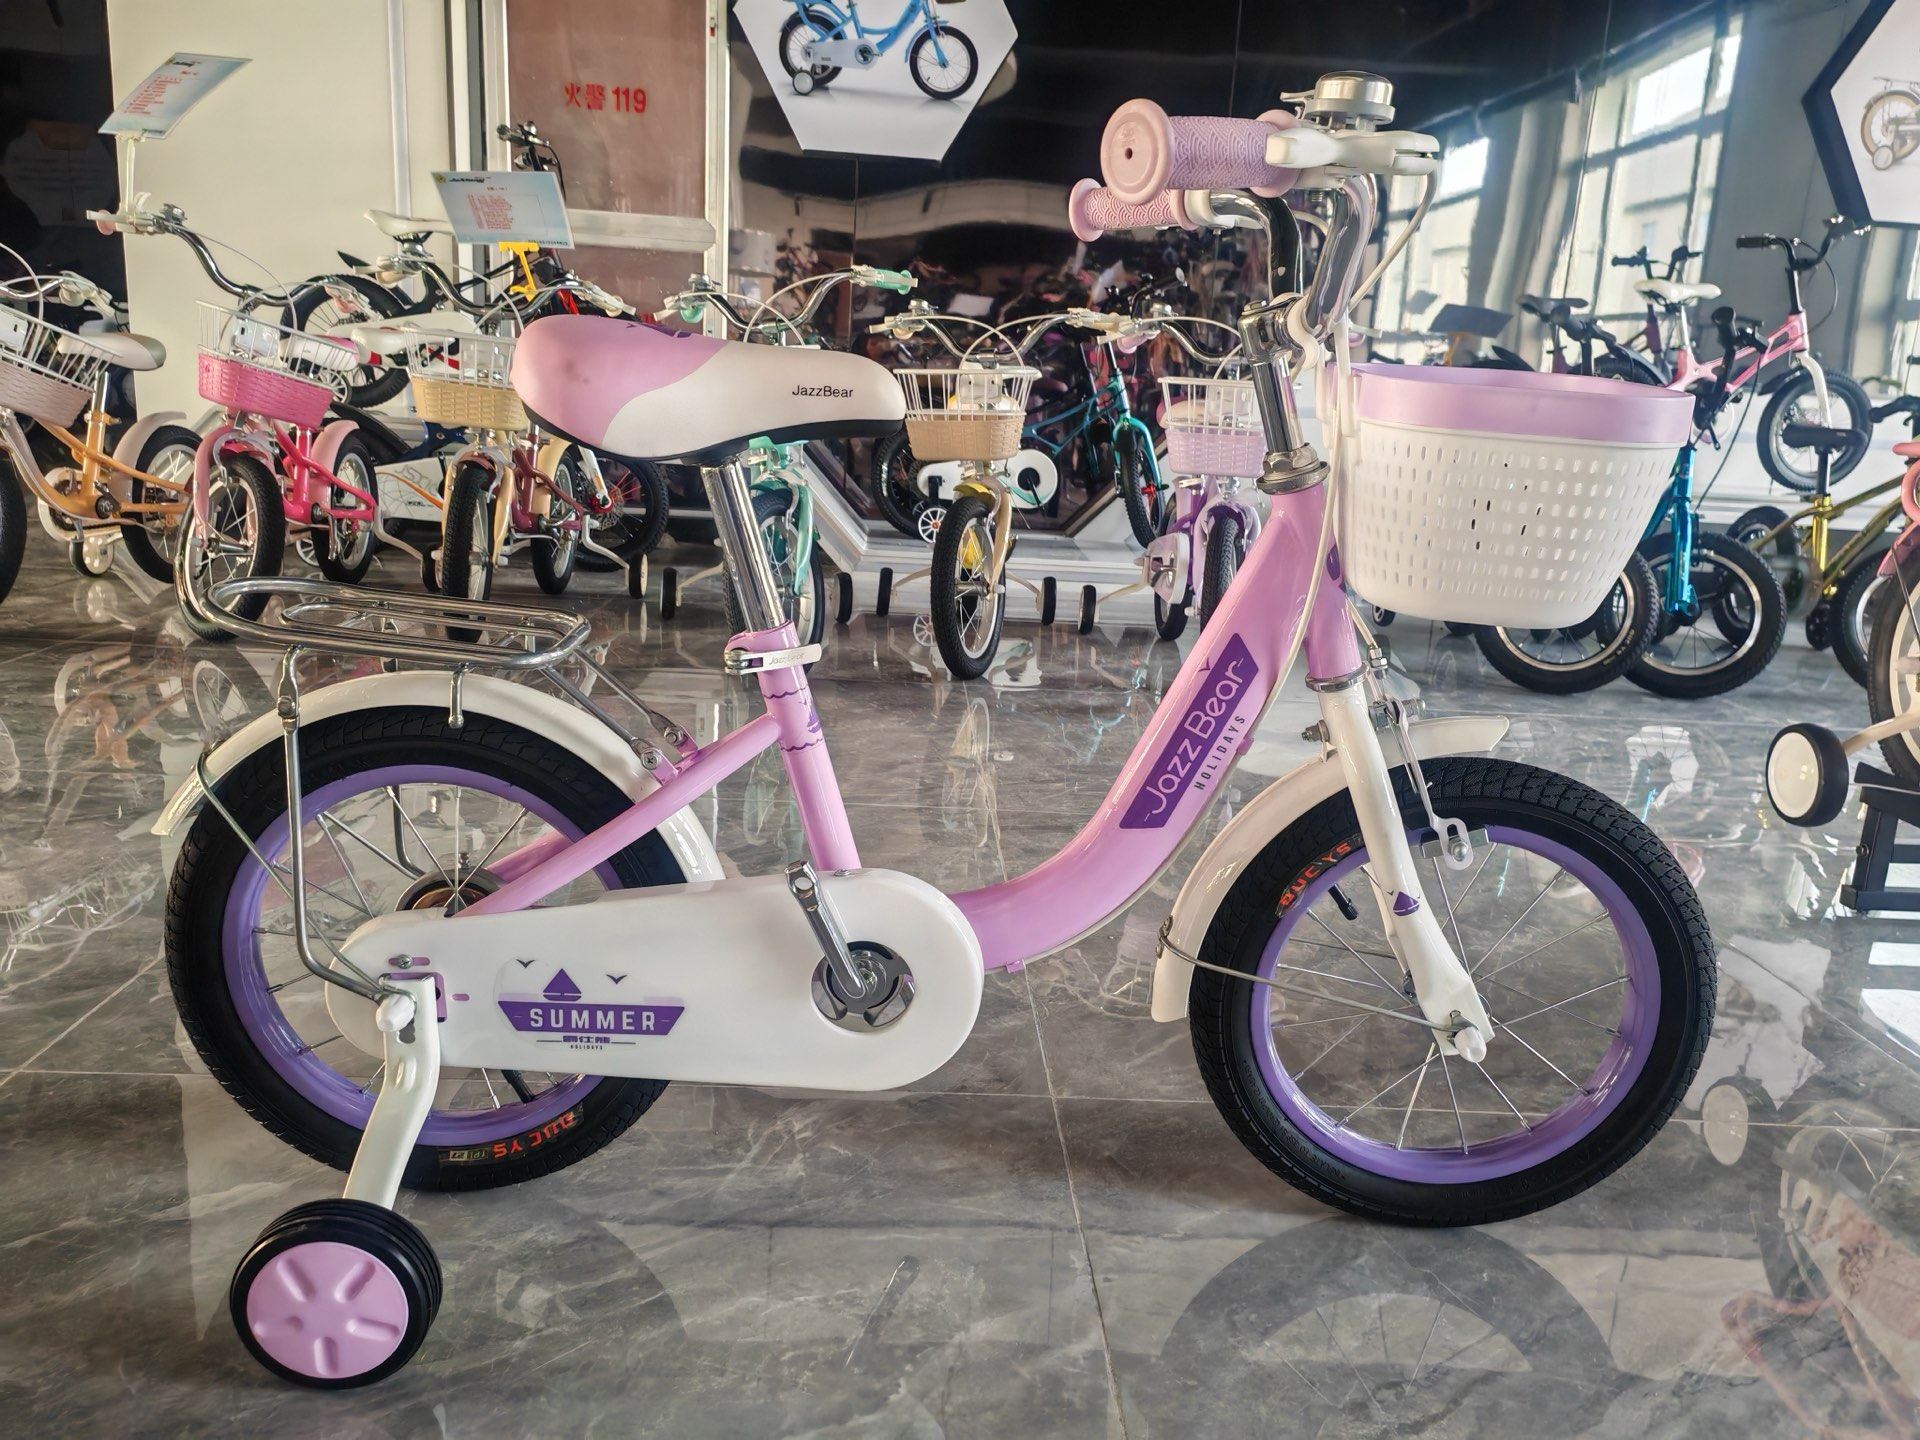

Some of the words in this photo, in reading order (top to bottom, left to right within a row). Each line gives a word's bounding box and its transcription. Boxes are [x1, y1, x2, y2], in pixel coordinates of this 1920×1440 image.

[792, 385, 853, 398] JazzBear
[1146, 738, 1202, 815] Jazz
[1184, 660, 1243, 739] Bear
[1194, 716, 1246, 790] HOLIDAYS
[530, 1008, 655, 1031] SUMMER
